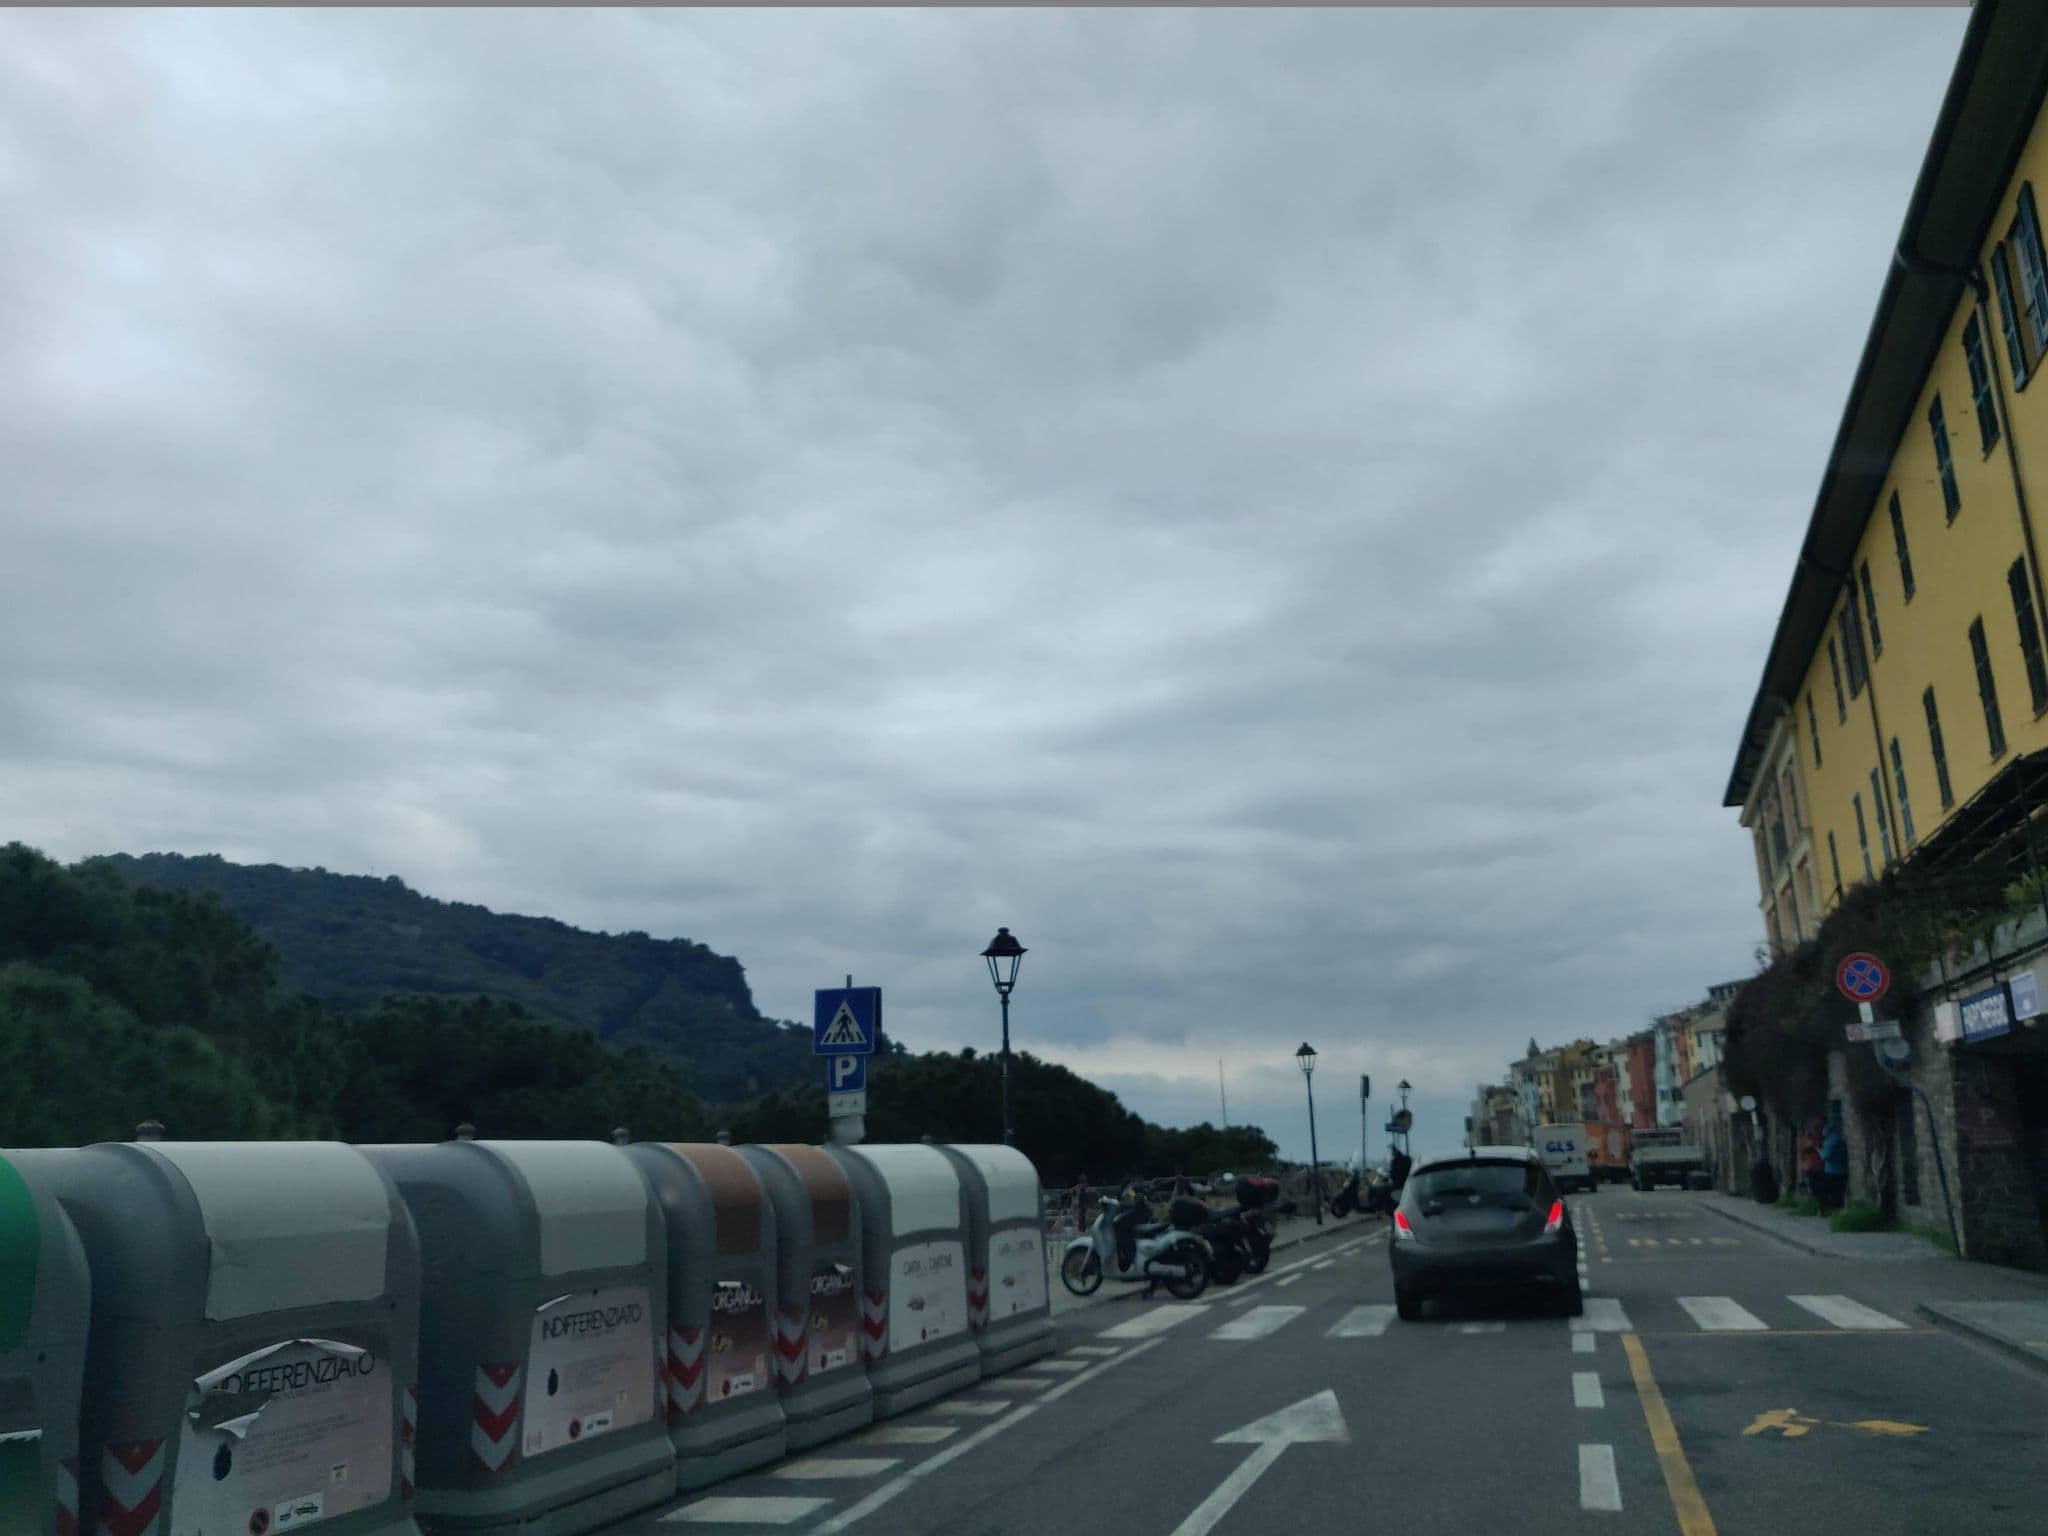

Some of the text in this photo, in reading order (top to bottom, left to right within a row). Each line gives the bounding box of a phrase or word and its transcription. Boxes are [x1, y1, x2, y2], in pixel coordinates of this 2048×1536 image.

[835, 1055, 858, 1088] P
[1546, 1139, 1575, 1153] GLS
[541, 1303, 642, 1339] INDIFFERENZIATO
